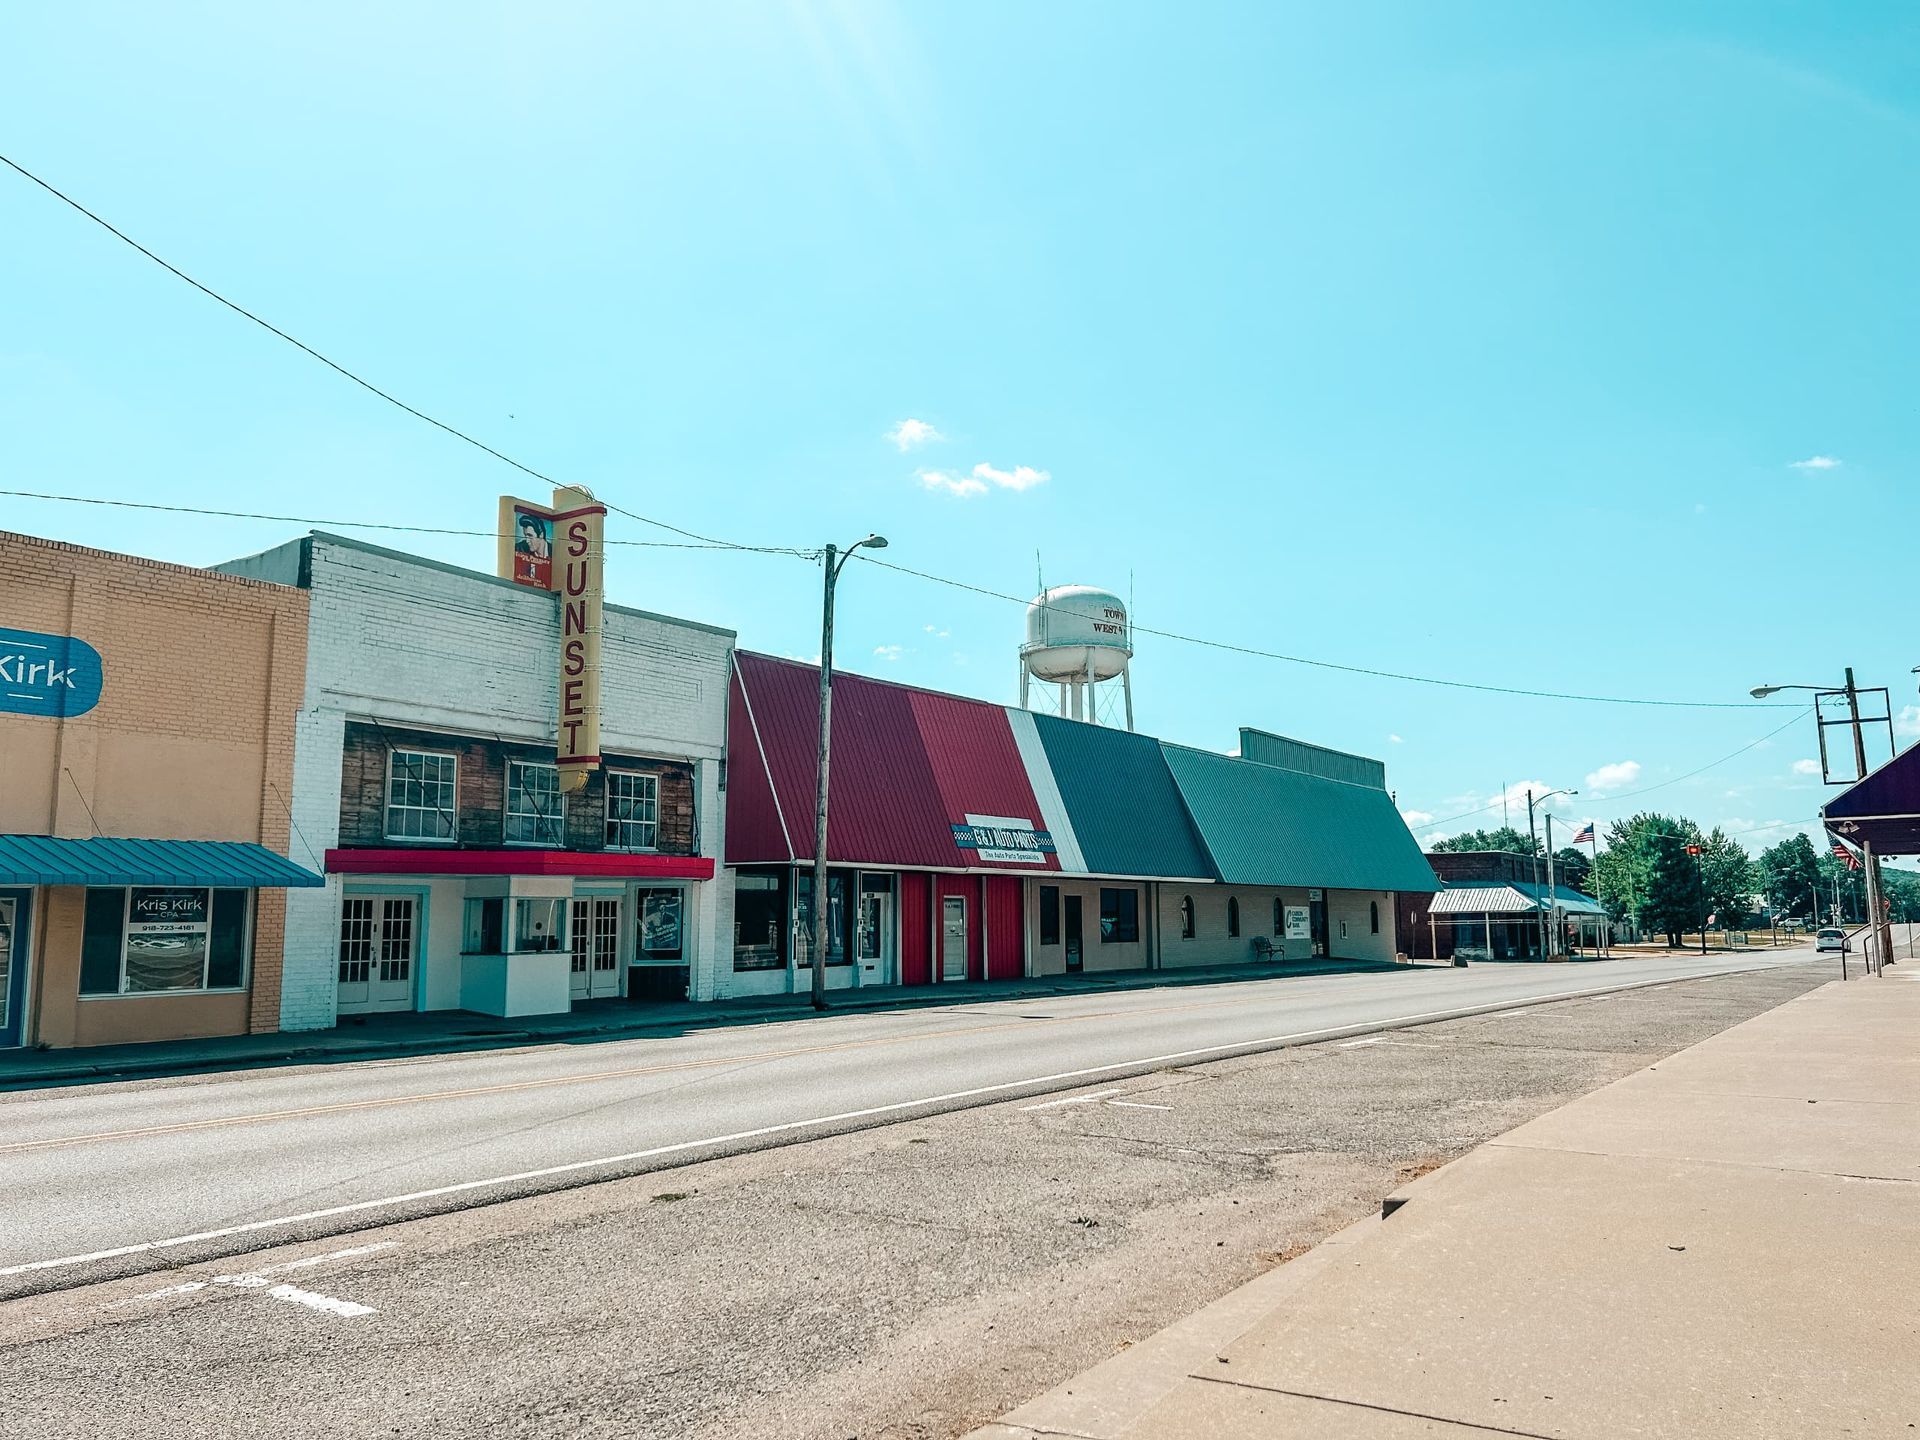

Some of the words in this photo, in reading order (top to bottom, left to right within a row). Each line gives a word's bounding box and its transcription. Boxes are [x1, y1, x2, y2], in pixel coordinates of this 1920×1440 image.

[563, 521, 588, 755] SUNSET
[0, 655, 77, 689] Kirk
[993, 829, 1015, 848] AUTO
[1014, 831, 1039, 849] PARTS
[137, 899, 168, 911] Kris
[172, 899, 202, 911] Kirk
